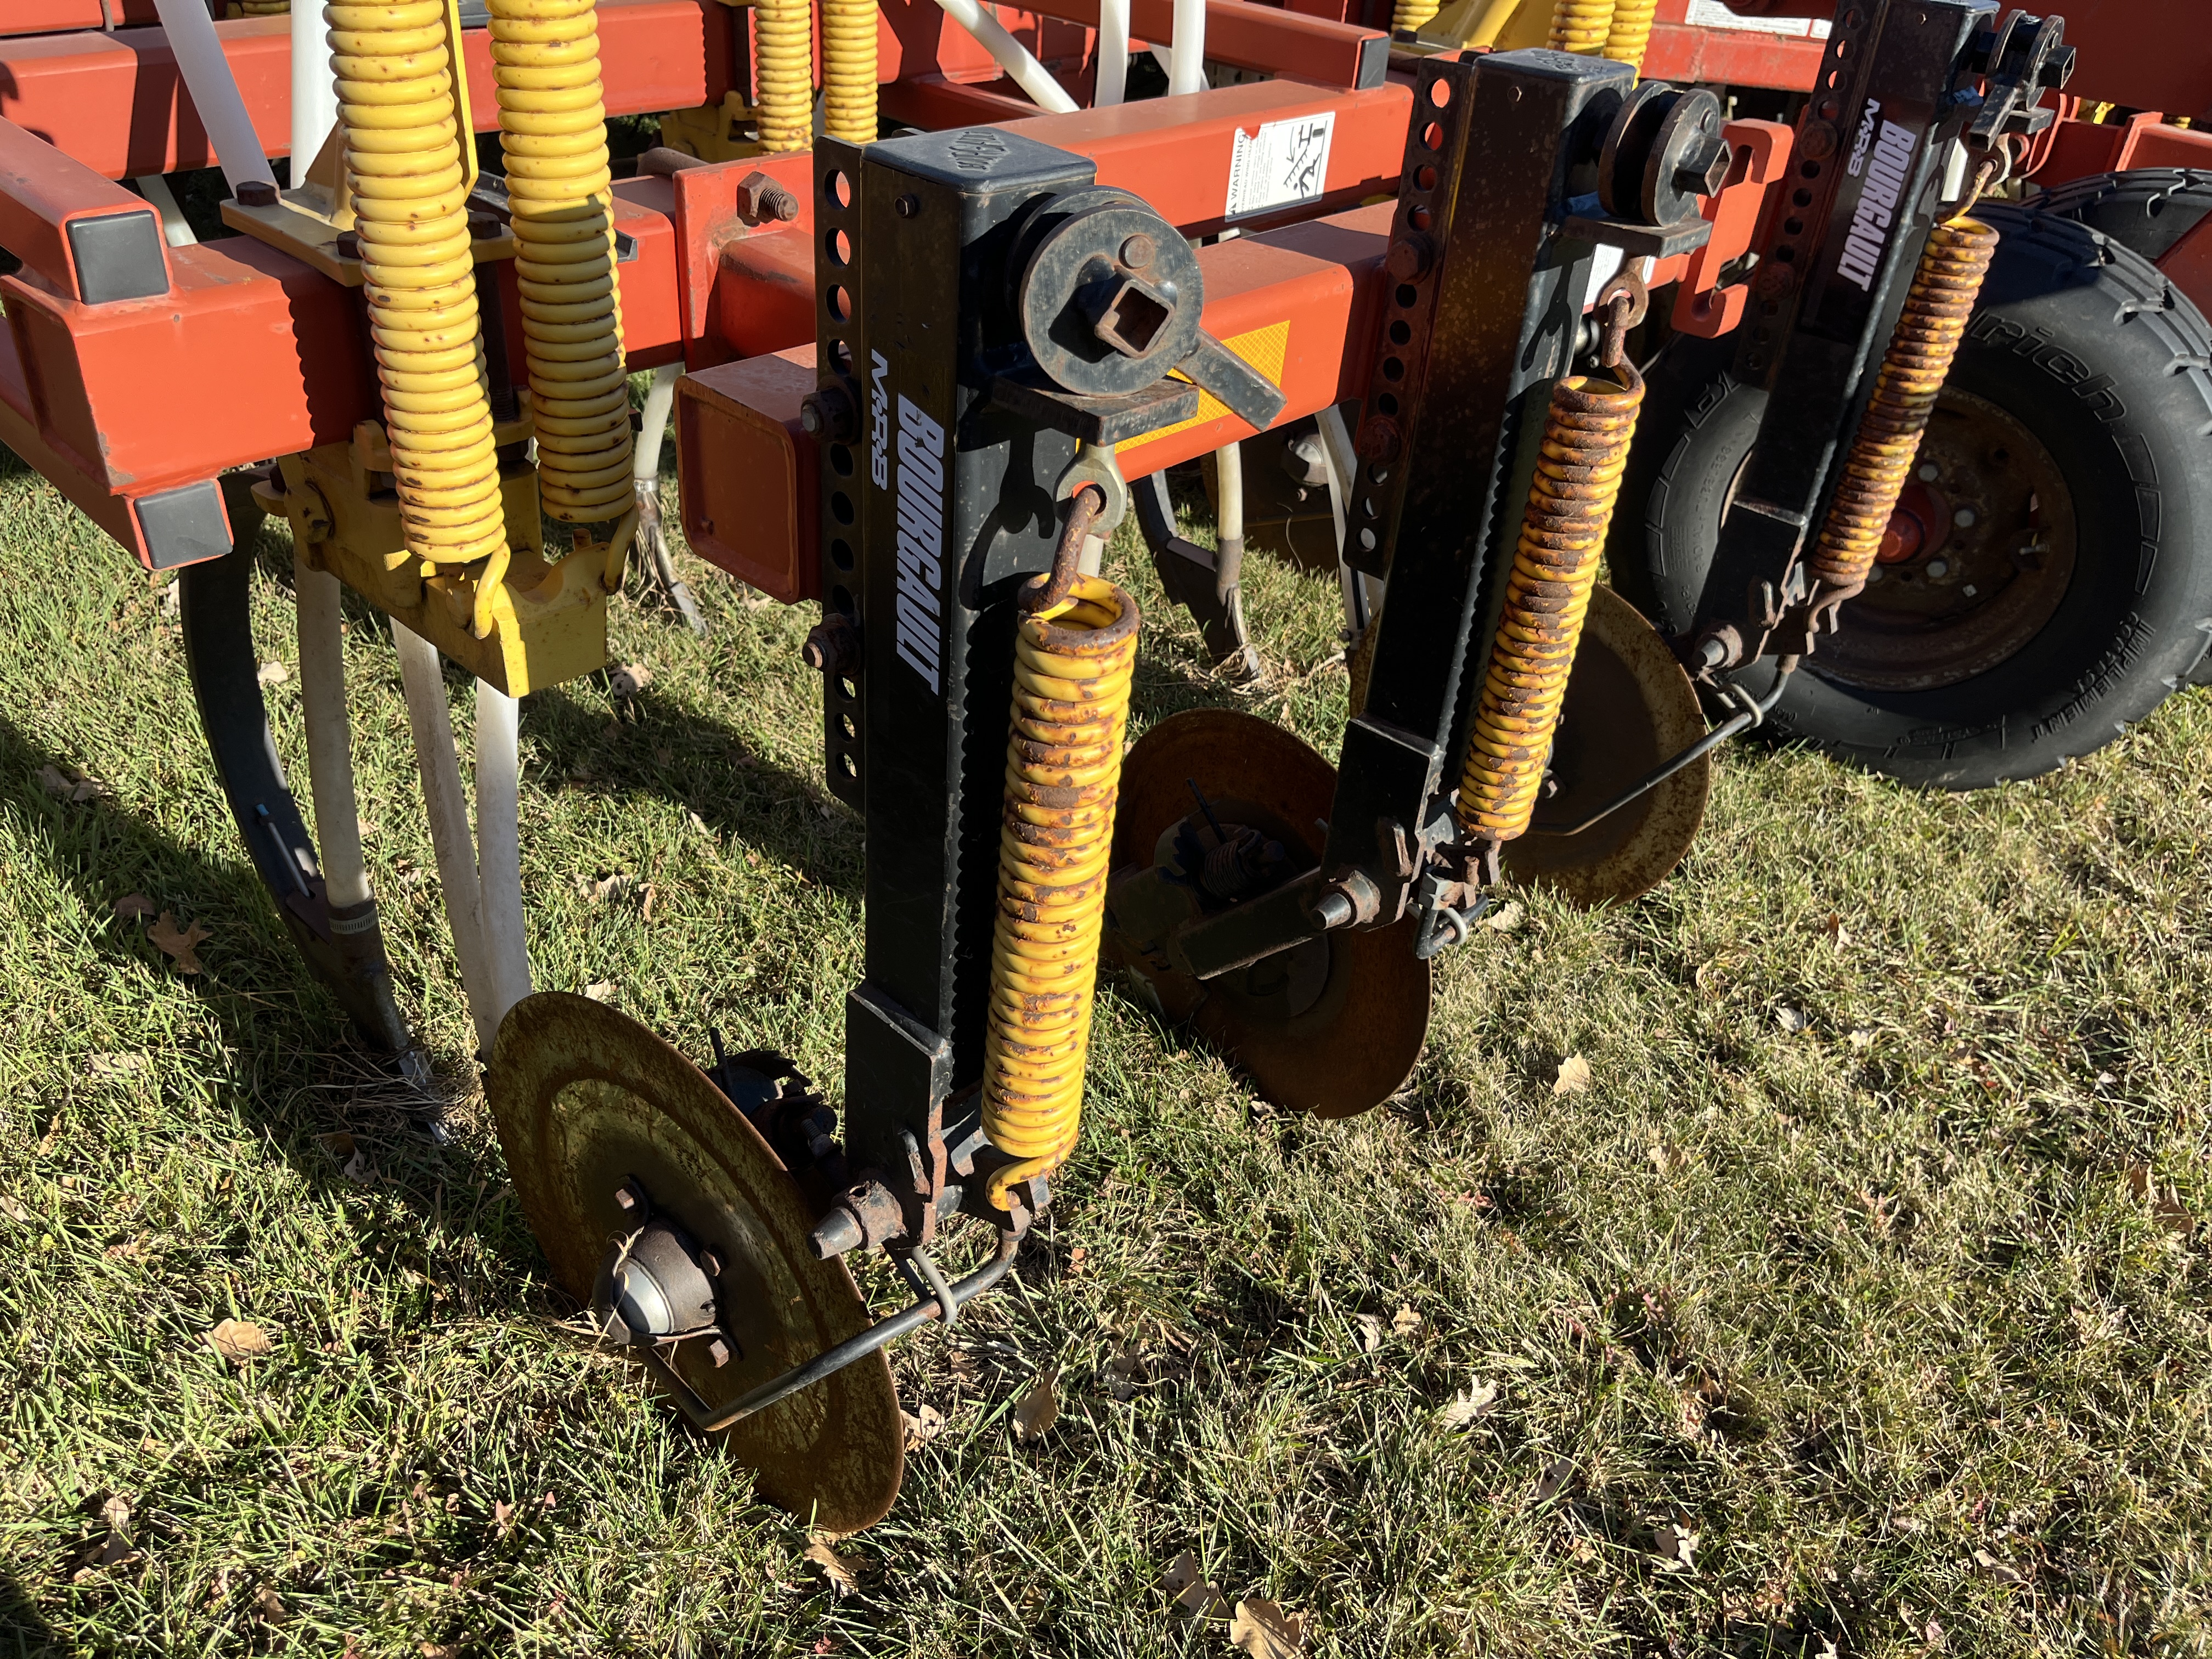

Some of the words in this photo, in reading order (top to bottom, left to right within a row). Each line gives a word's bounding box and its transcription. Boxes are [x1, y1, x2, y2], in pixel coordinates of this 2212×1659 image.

[1231, 134, 1246, 200] WARNING
[1837, 119, 1916, 292] BOURGAULT
[1964, 308, 2127, 423] rich
[896, 392, 944, 696] BOURGAULT
[2032, 619, 2157, 743] IMPLEMENT
